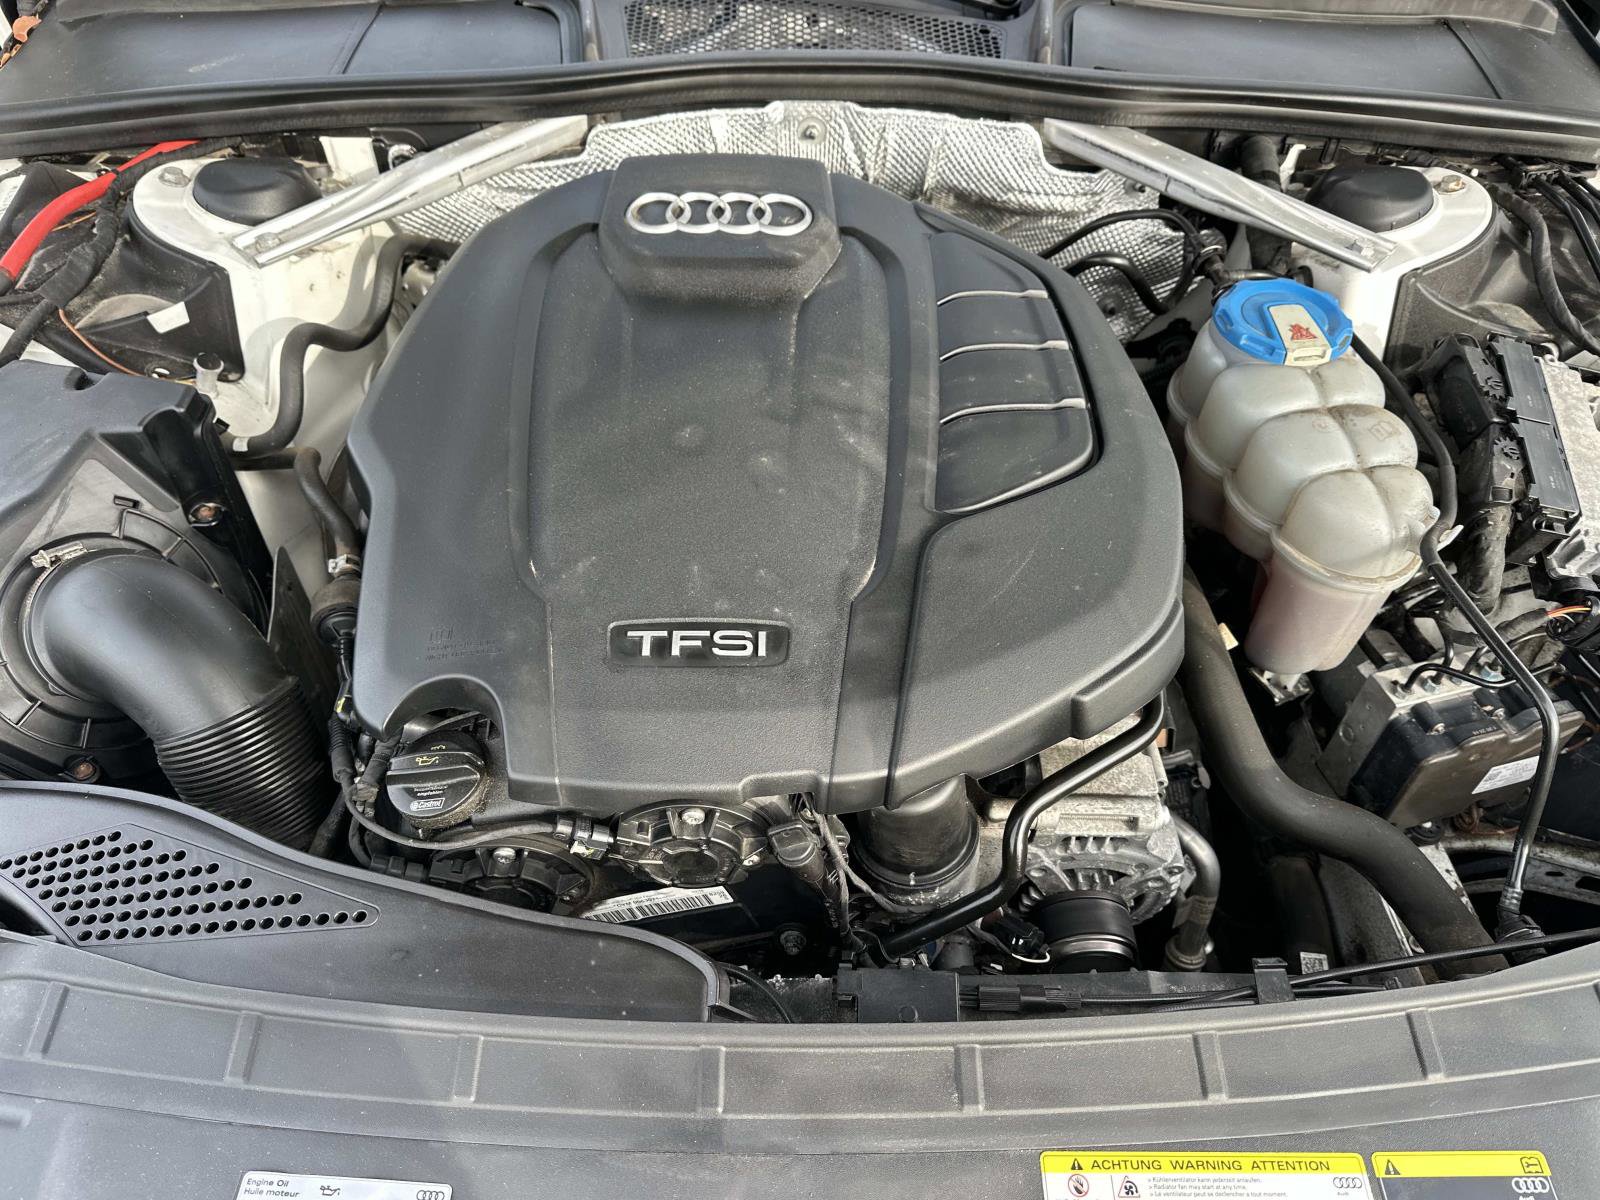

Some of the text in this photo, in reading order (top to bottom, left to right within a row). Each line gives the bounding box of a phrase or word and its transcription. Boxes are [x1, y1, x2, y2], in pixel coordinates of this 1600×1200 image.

[627, 630, 767, 657] TFSI
[418, 800, 442, 808] Castrol
[1091, 1159, 1330, 1171] ACHTUNG WARNING ATTENTION
[246, 1178, 289, 1187] Engine Oil
[243, 1187, 300, 1198] Huile moteur
